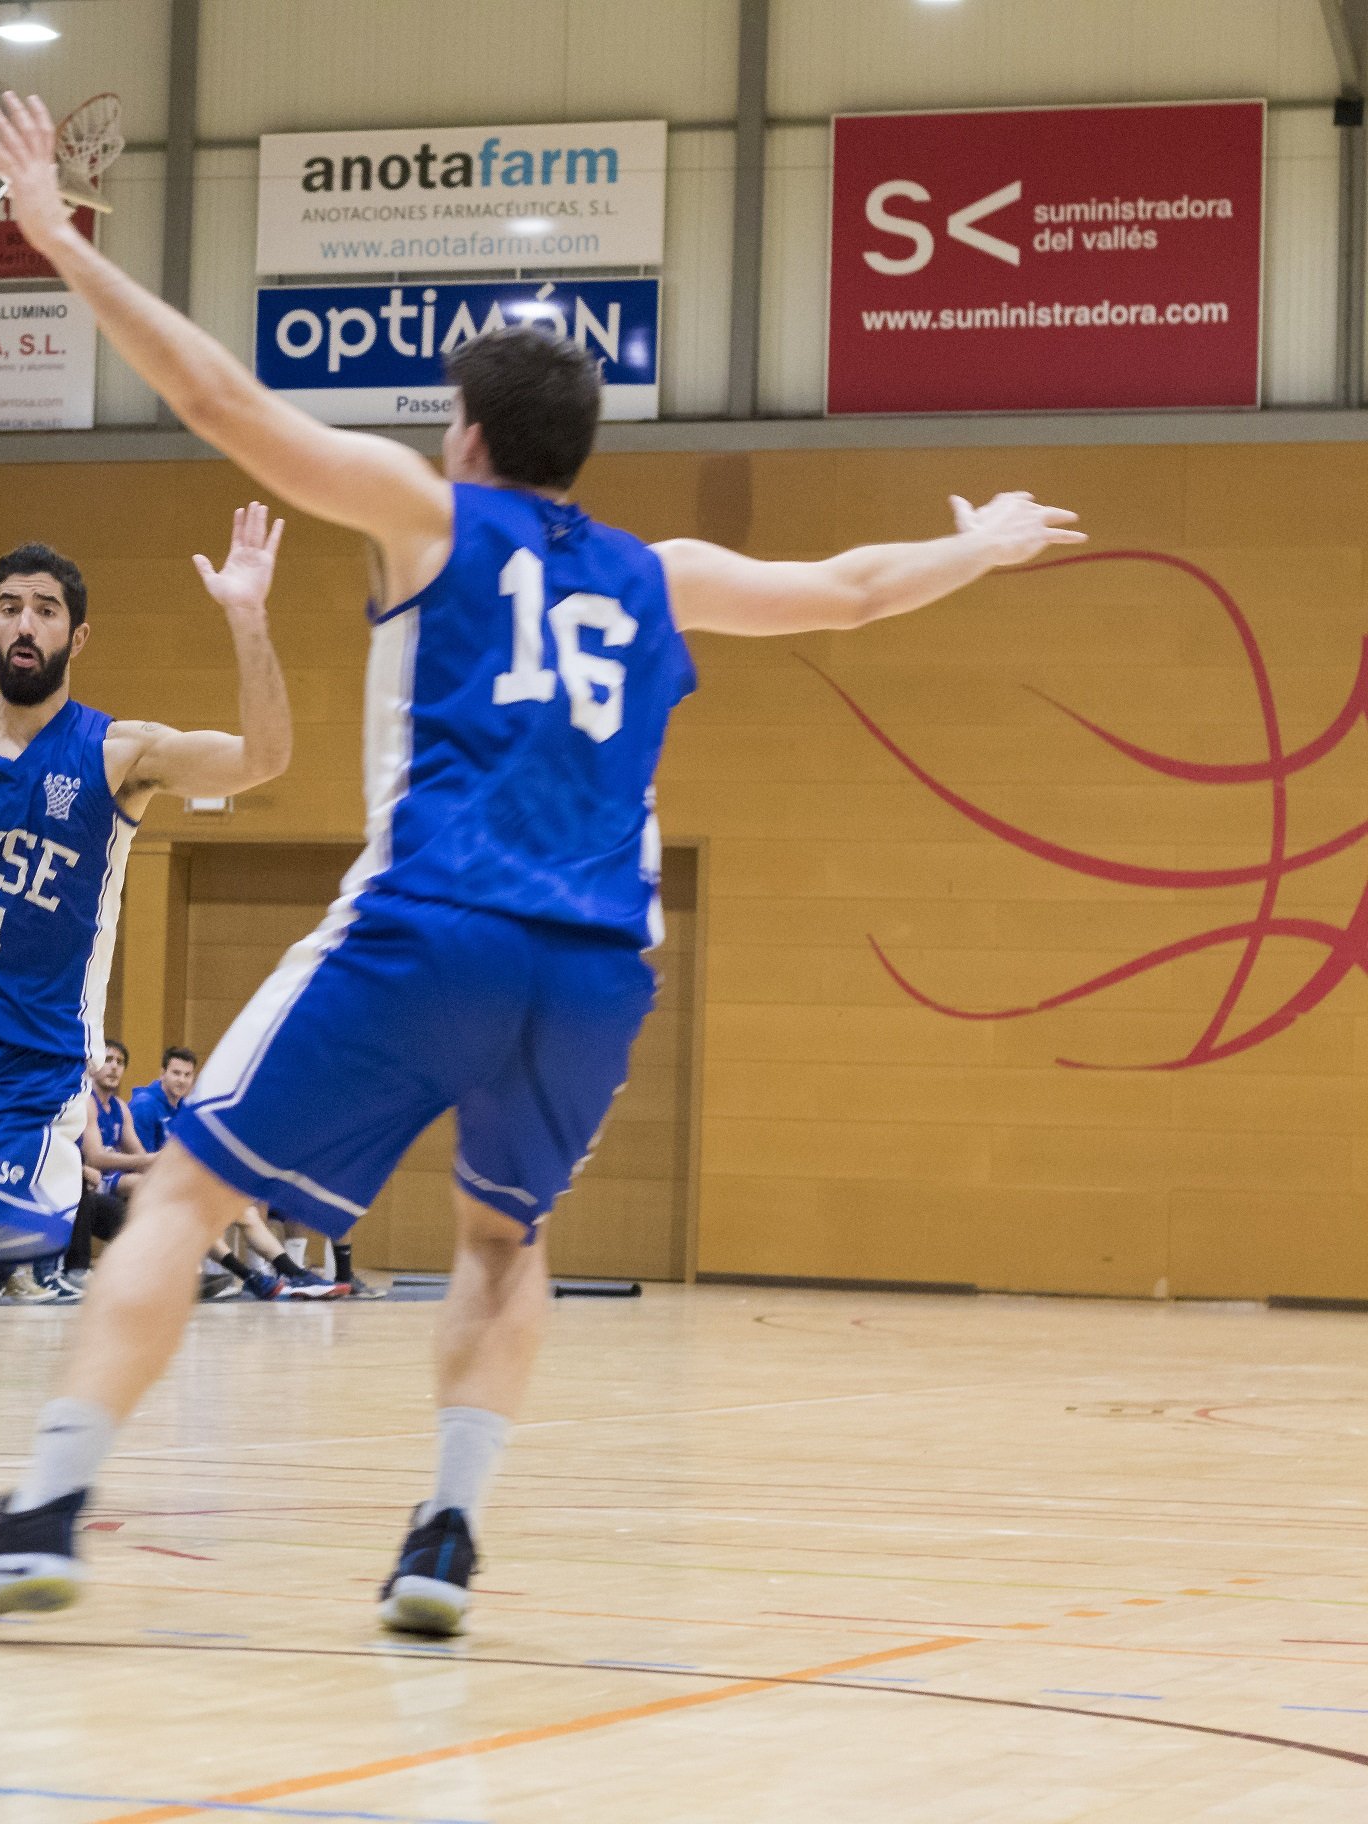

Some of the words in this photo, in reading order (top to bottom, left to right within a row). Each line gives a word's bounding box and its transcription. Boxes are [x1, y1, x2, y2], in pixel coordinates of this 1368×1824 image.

[301, 137, 619, 192] anotafarm
[301, 205, 427, 222] ANOTACIONES
[589, 199, 618, 216] S.L.
[1034, 195, 1233, 224] suministradora
[321, 231, 599, 259] www.anotafarm.com
[1033, 229, 1073, 253] del
[1082, 224, 1158, 250] vallés
[862, 301, 1229, 331] www.suministradora.com
[19, 334, 67, 355] S.L.
[493, 546, 639, 744] 16
